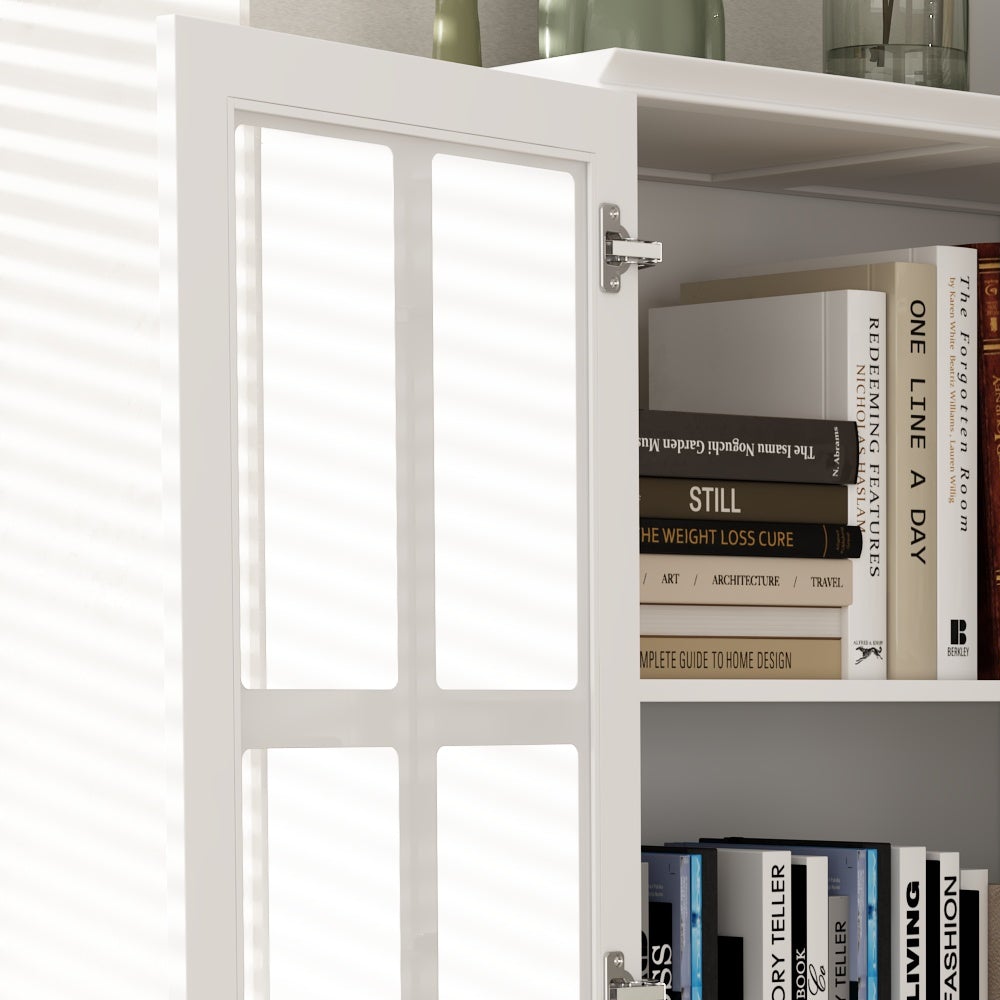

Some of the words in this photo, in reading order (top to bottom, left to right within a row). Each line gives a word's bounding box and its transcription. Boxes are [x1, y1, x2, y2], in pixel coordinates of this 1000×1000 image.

[948, 277, 956, 287] by
[960, 276, 970, 317] The
[910, 299, 926, 354] ONE
[869, 317, 880, 453] REDEEMING
[957, 331, 970, 452] Forgotten
[910, 378, 926, 449] LINE
[663, 438, 705, 454] Garden
[707, 437, 755, 457] Noguchi
[757, 443, 792, 458] Isamu
[794, 445, 816, 460] The
[832, 426, 840, 466] Abrams
[832, 466, 840, 477] N.
[910, 469, 926, 489] A
[689, 486, 741, 513] STILL
[948, 475, 956, 504] Willig
[960, 467, 970, 532] Room
[869, 464, 880, 577] FEATURES
[639, 527, 659, 544] HE
[662, 527, 717, 545] WEIGHT
[721, 529, 756, 546] LOSS
[758, 530, 794, 547] CURE
[910, 509, 926, 565] DAY
[661, 573, 680, 584] ART
[712, 574, 780, 587] ARCHITECTURE
[811, 576, 844, 588] TRAVEL
[679, 651, 708, 669] GUIDE
[711, 651, 724, 669] TO
[726, 651, 754, 669] HOME
[757, 651, 792, 669] DESIGN
[947, 647, 970, 657] BERKLEY
[771, 865, 786, 945] TELLER
[835, 921, 847, 987] TELLER
[796, 948, 806, 1000] BOOK
